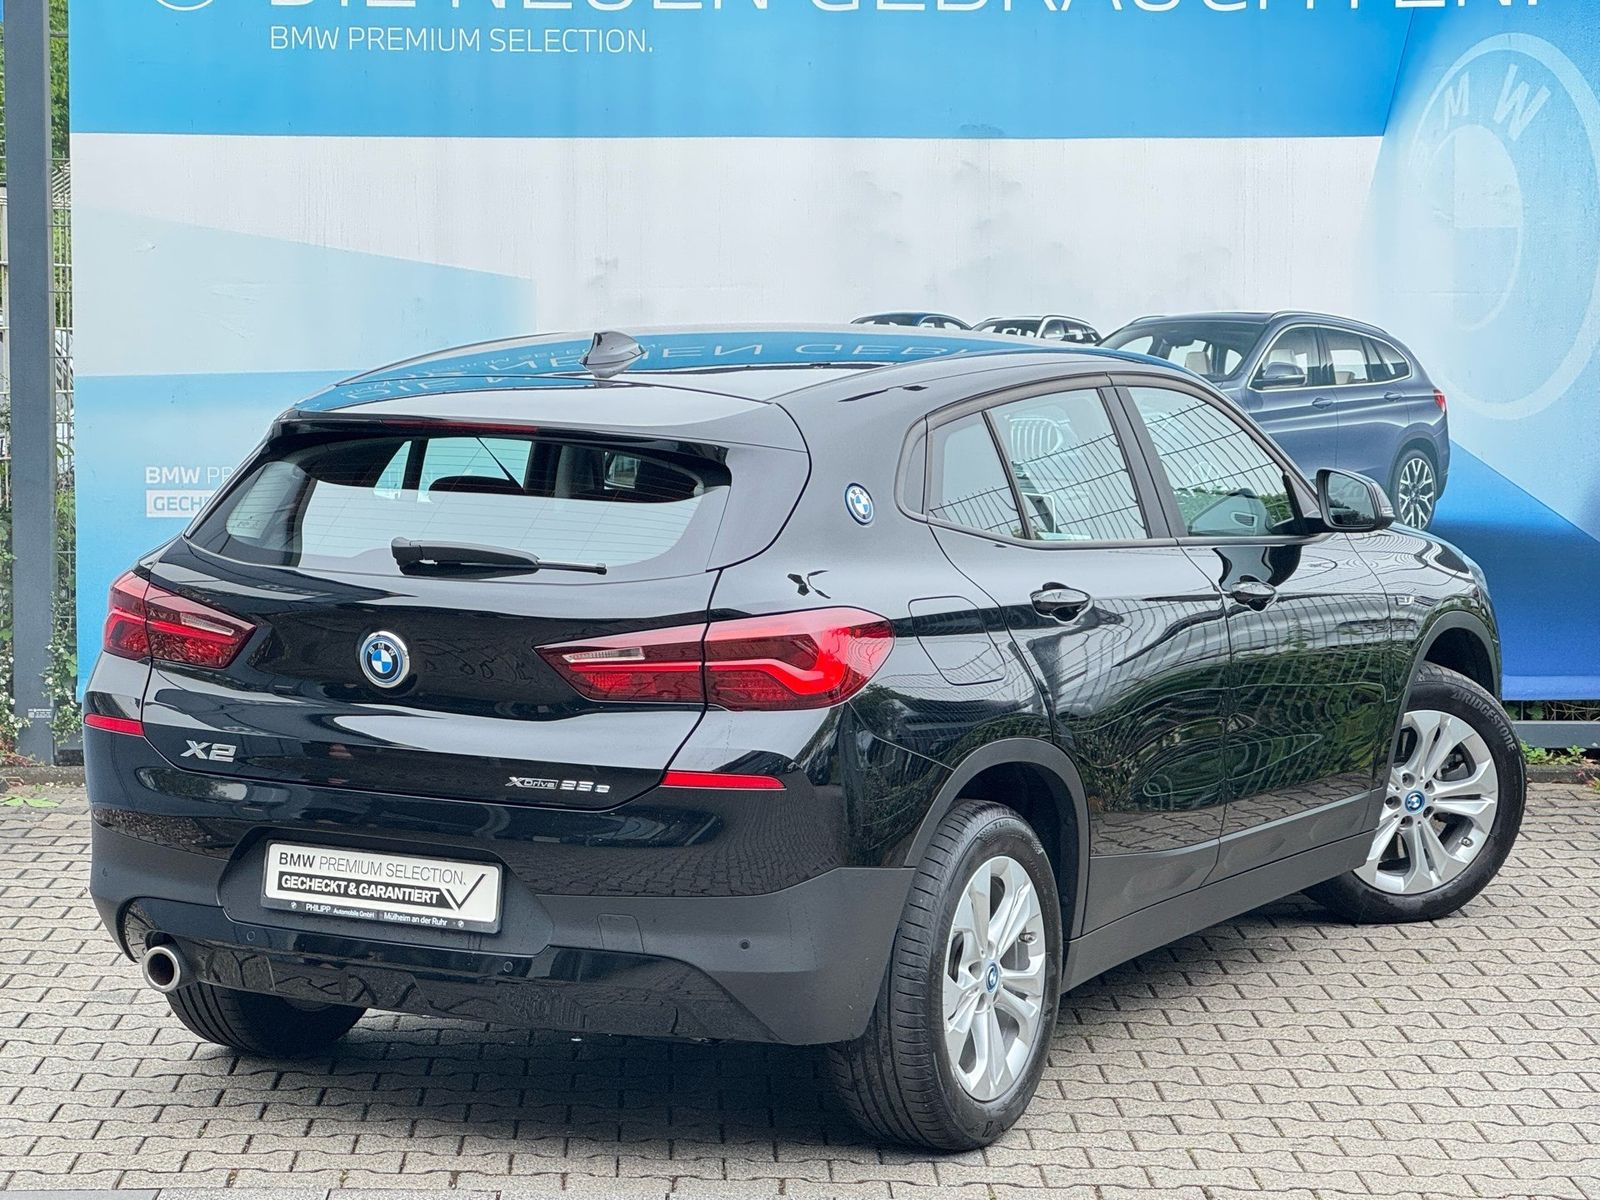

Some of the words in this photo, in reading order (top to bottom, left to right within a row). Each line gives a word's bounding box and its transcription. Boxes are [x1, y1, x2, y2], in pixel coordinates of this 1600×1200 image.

[270, 26, 339, 50] BMW
[348, 27, 480, 52] PREMIUM
[489, 28, 654, 53] SELECTION.
[145, 466, 200, 484] BMW
[207, 466, 235, 484] PR
[153, 496, 208, 511] GECH
[180, 739, 237, 762] X2
[279, 852, 315, 869] BMW
[319, 856, 383, 877] PREMIUM
[385, 863, 467, 886] SELECTION.
[280, 874, 347, 893] GECHECKT
[347, 884, 357, 895] &
[358, 883, 440, 904] GARANTIERT
[305, 903, 332, 913] PHILIPP
[333, 907, 359, 917] Automobile
[359, 910, 375, 919] GmbH
[383, 911, 411, 922] Mülheim
[411, 914, 420, 923] an
[420, 915, 431, 925] der
[431, 917, 448, 927] Ruhr
